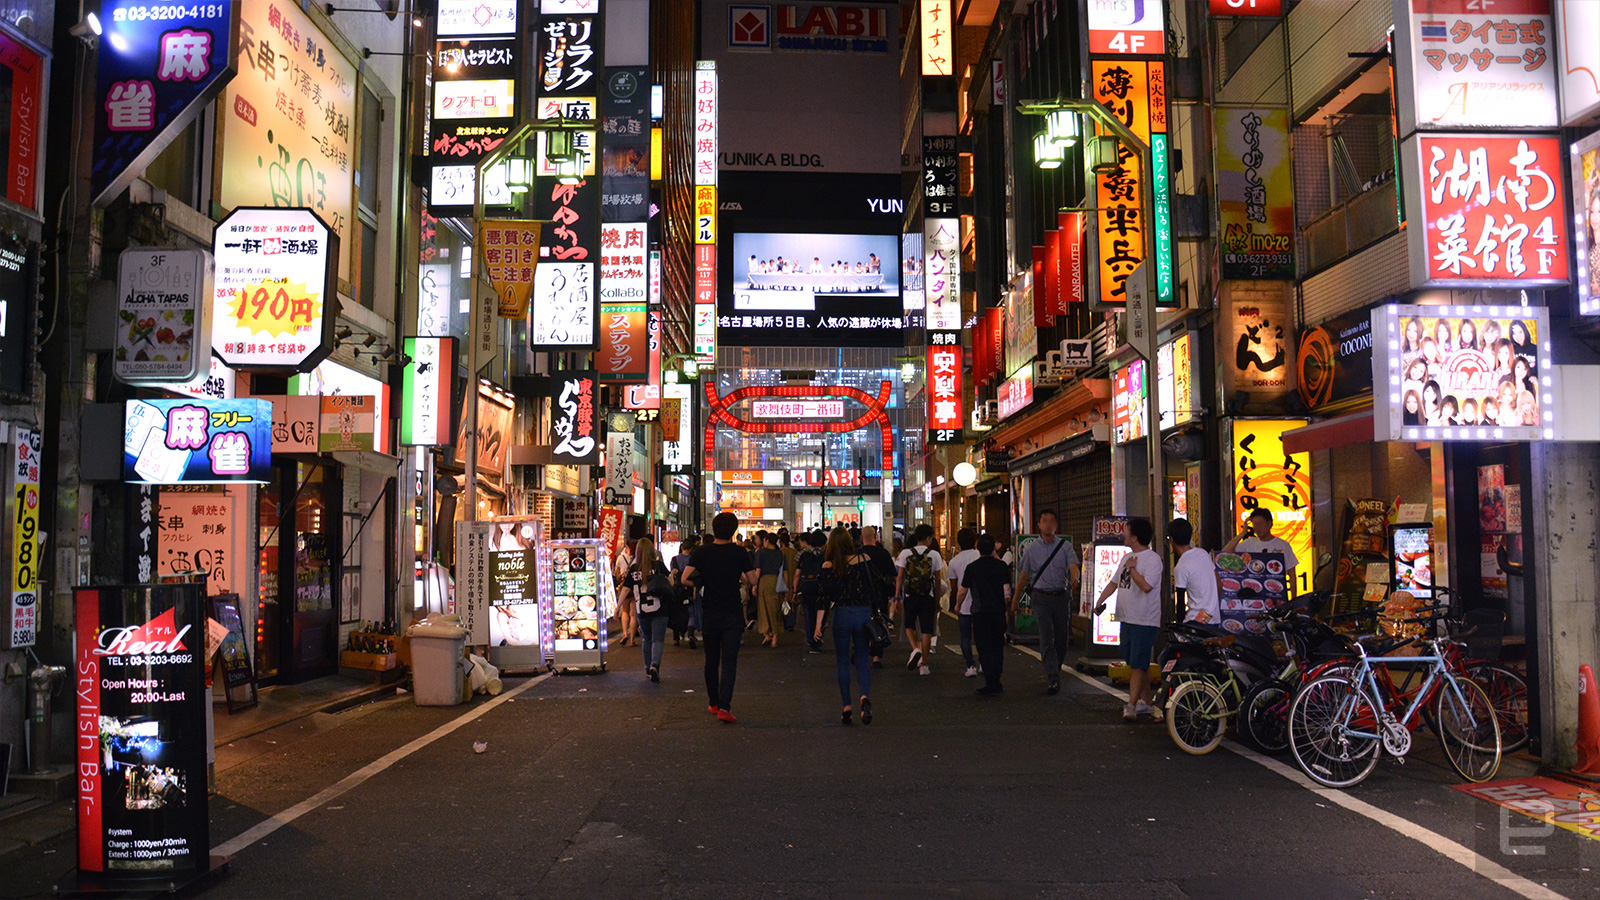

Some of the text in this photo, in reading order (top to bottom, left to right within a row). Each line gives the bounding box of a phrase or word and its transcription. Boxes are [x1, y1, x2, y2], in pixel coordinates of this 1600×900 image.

[127, 5, 223, 20] 03-3200-4181
[268, 3, 300, 52] 網焼き
[777, 6, 887, 36] LABI
[928, 3, 946, 75] すずや
[1450, 20, 1545, 44] タイ古式
[1108, 32, 1145, 53] 4F
[1423, 47, 1546, 72] マッサージ
[1472, 82, 1545, 91] アジアンリラックス
[442, 96, 496, 109] クアトロ
[1150, 69, 1165, 124] 炭火串焼
[324, 100, 349, 145] 焼酎
[697, 80, 714, 176] お好み焼き
[781, 154, 824, 168] BLDG.
[697, 187, 713, 215] 麻雀
[930, 203, 953, 212] 3F
[486, 230, 535, 246] 悪質な
[601, 228, 644, 249] 焼肉
[151, 256, 166, 266] 3F
[486, 249, 535, 264] 客引き
[1237, 254, 1292, 264] 03-6273-9351
[487, 266, 534, 283] に注意
[930, 249, 946, 307] バンタイ
[1071, 243, 1081, 299] ANRAKUTEI
[1250, 265, 1267, 276] 2F
[125, 289, 189, 304] ALOHA TAPAS
[699, 290, 711, 300] 4F
[483, 297, 492, 351] 劇場通り一番街
[608, 313, 632, 371] ステップ
[933, 333, 956, 344] 焼肉
[1340, 333, 1372, 357] COCON
[224, 343, 306, 354] 朝8時まで営業中
[934, 351, 955, 423] 安楽亭
[755, 402, 842, 417] 歌舞伎町一番街
[212, 411, 252, 428] フリー
[937, 430, 954, 441] 2F
[807, 470, 860, 486] LABI
[865, 469, 900, 478] SHINKU
[192, 505, 227, 515] 網焼き
[565, 501, 586, 511] 焼肉
[202, 524, 226, 534] 刺身
[163, 534, 193, 542] フカヒレ
[498, 558, 525, 571] noble
[93, 624, 192, 656] Real
[107, 655, 192, 666] TEL 03-3203-6692
[102, 679, 158, 690] Open Hours
[131, 692, 185, 703] 20:00-Last
[108, 838, 187, 849] Charge 1000yen/30min
[133, 850, 161, 859] 1000yen
[167, 847, 189, 855] 30min
